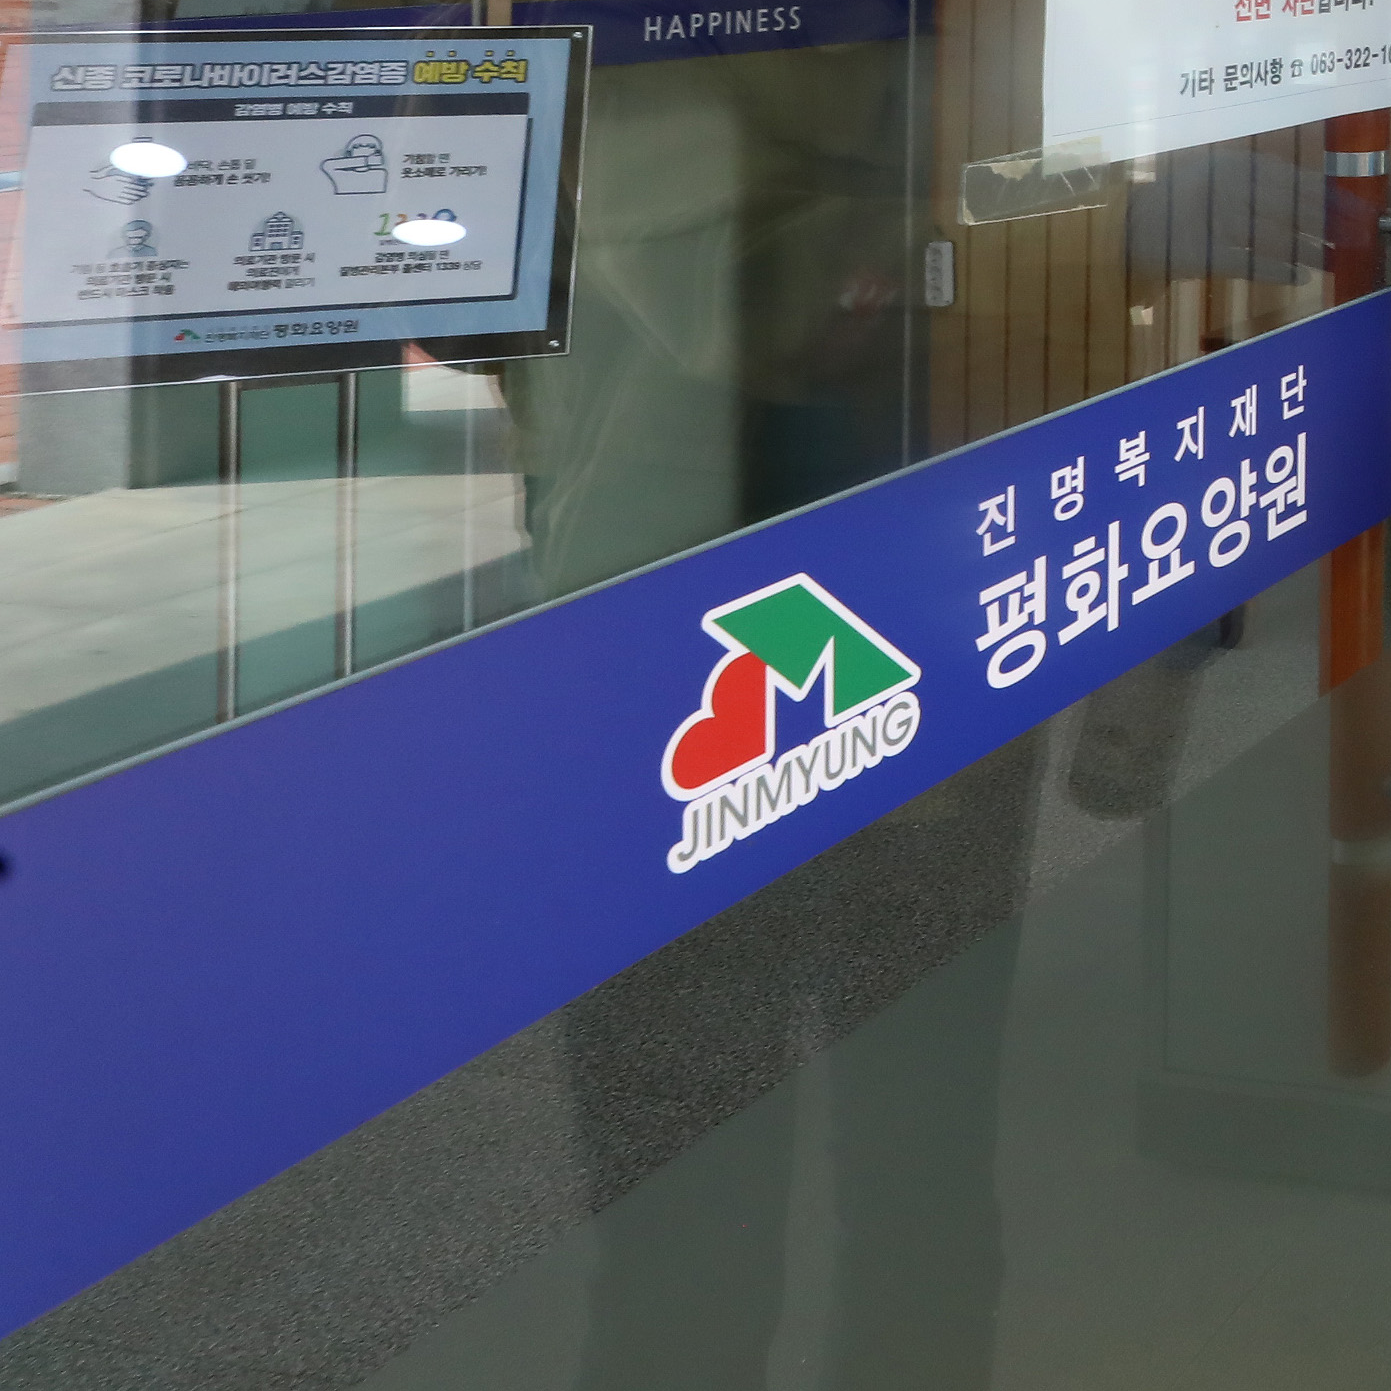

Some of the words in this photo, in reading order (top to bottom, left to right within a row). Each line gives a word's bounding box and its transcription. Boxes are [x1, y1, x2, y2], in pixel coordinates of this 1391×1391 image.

[643, 6, 802, 42] HAPPINESS
[52, 64, 117, 92] 신종
[119, 60, 408, 91] 코로나바이러스감염증
[413, 59, 469, 84] 예방
[472, 58, 529, 84] 수칙
[1179, 67, 1215, 98] 기타
[1223, 57, 1284, 93] 문의사항
[286, 102, 320, 116] 예방
[321, 101, 353, 115] 수칙
[273, 320, 360, 339] 평화요양원
[975, 365, 1308, 557] 진명복지재단
[975, 432, 1308, 690] 평화요양원
[675, 698, 917, 866] JINMYUNG
